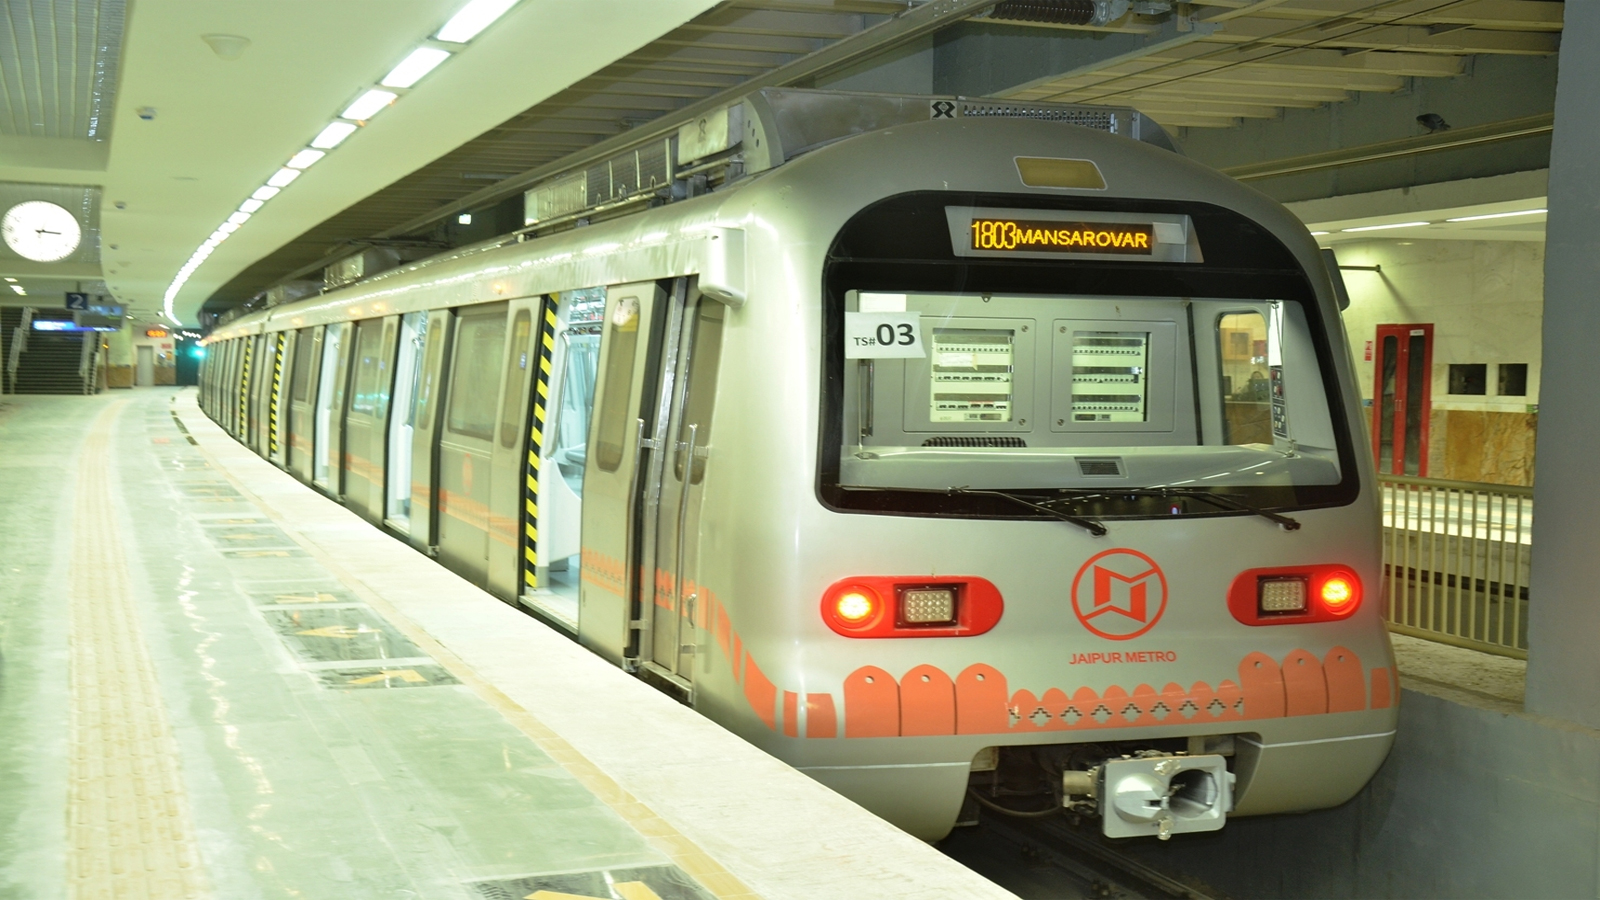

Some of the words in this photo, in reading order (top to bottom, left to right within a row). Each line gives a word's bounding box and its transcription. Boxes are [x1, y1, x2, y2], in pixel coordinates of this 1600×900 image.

[971, 221, 1016, 249] 1803
[1016, 228, 1147, 248] MANSAROVAR
[70, 294, 84, 308] 2
[1069, 652, 1123, 665] JAIPUR
[1125, 651, 1177, 662] METRO
